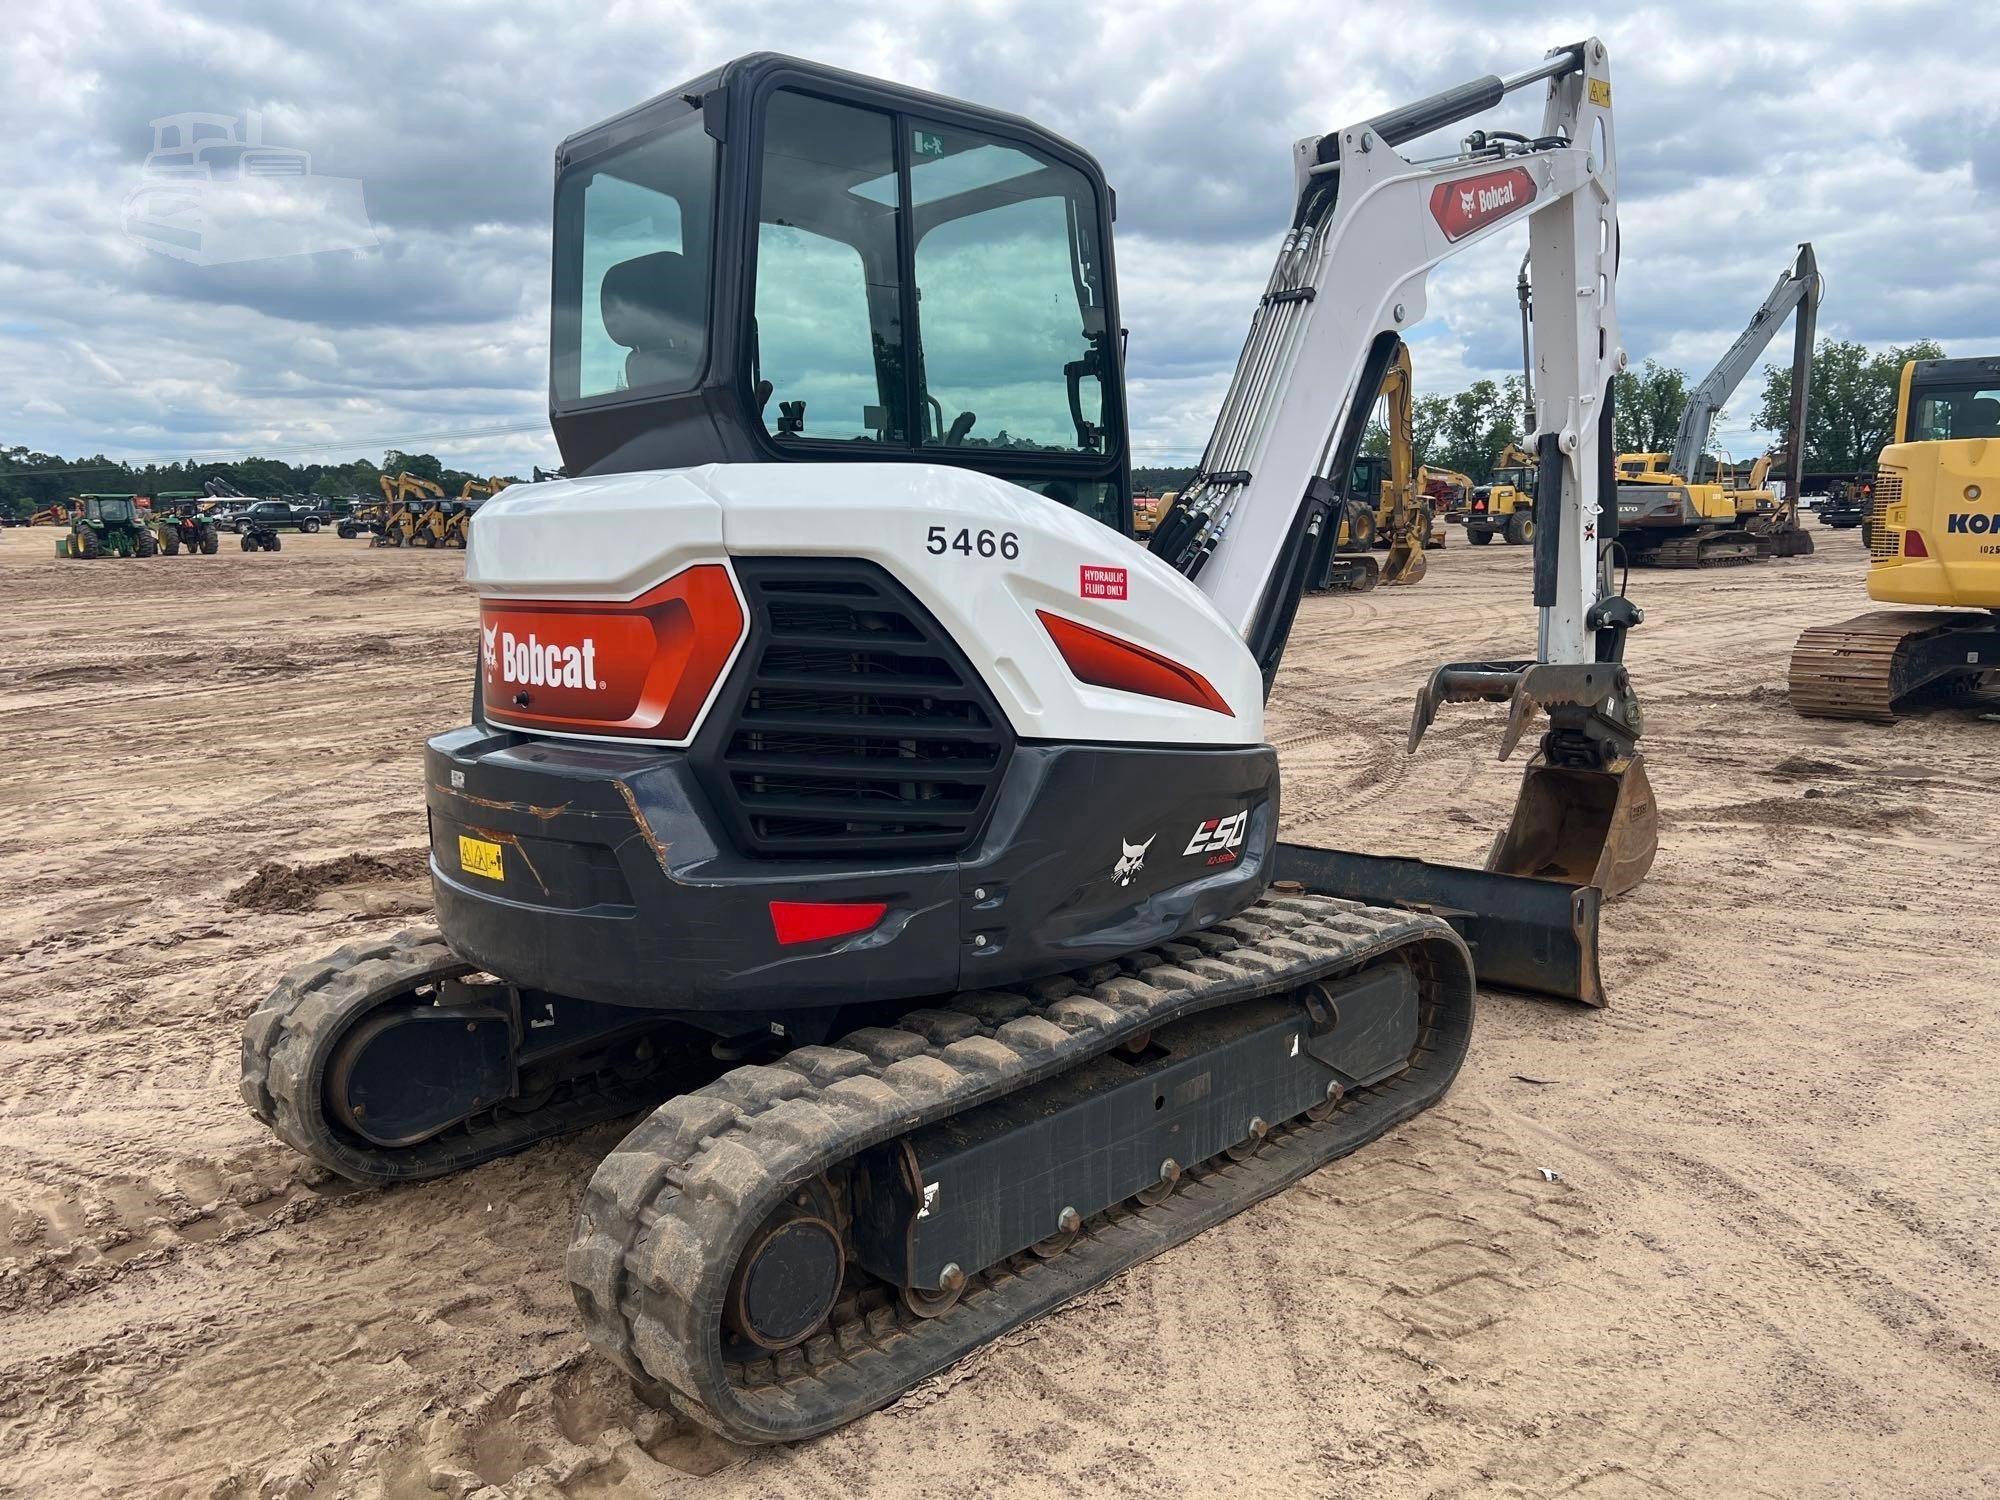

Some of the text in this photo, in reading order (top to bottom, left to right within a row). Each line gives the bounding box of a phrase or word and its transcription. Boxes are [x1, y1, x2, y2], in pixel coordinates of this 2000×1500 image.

[1478, 180, 1515, 213] Bobcat
[926, 526, 1020, 560] 5466
[1084, 569, 1125, 583] HYDRAULIC
[1084, 582, 1124, 596] FLUID ONLY
[502, 631, 598, 690] Bobcat
[1182, 809, 1248, 856] E50
